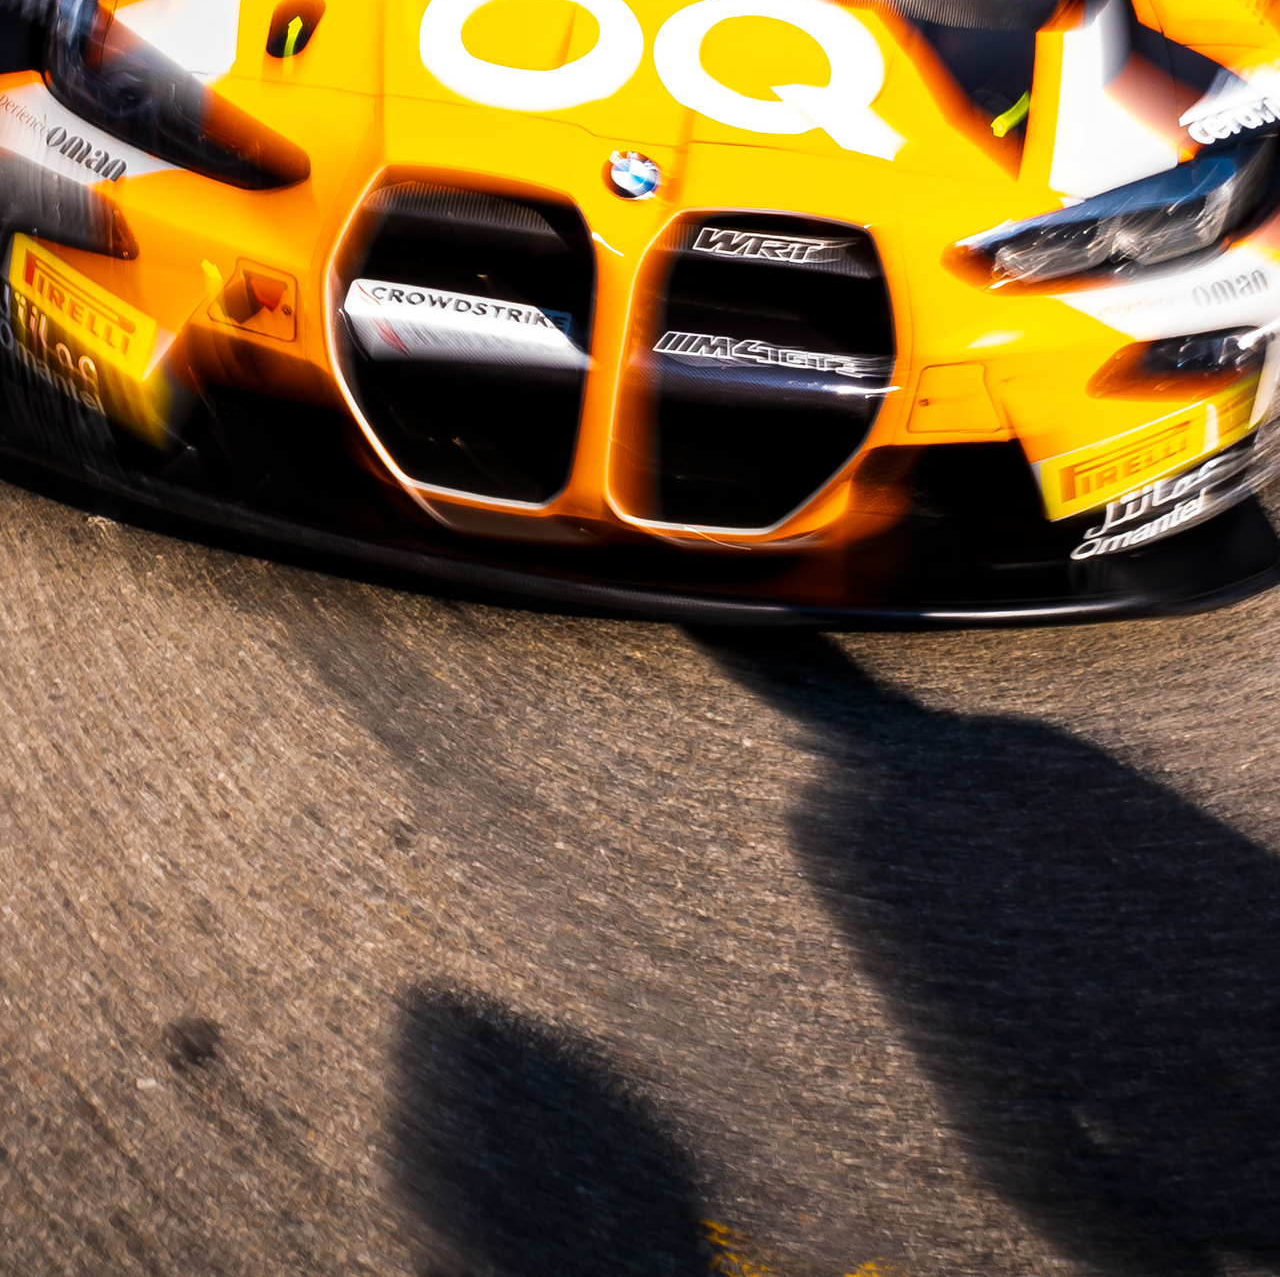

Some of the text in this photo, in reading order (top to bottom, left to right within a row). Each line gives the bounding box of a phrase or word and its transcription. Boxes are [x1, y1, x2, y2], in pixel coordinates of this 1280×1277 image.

[692, 227, 823, 264] WRT
[23, 248, 136, 356] PIRELLI
[1058, 421, 1192, 504] PIRELLI
